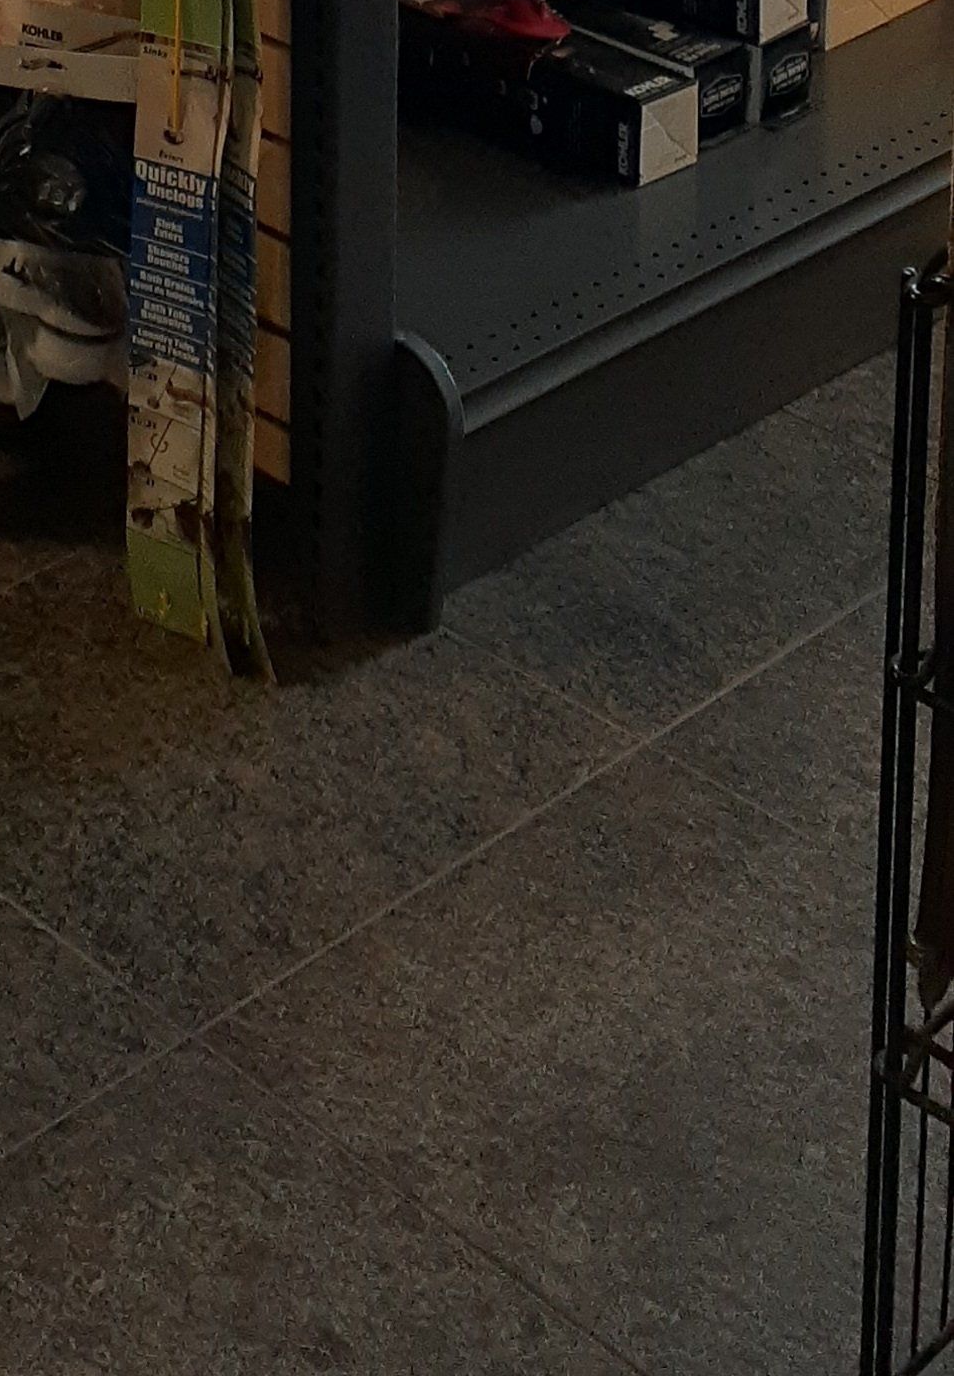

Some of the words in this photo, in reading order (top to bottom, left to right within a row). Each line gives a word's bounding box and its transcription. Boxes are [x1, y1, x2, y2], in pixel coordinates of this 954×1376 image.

[22, 23, 64, 41] KOHLER
[135, 160, 207, 197] Quickly
[146, 181, 204, 209] Unclogs
